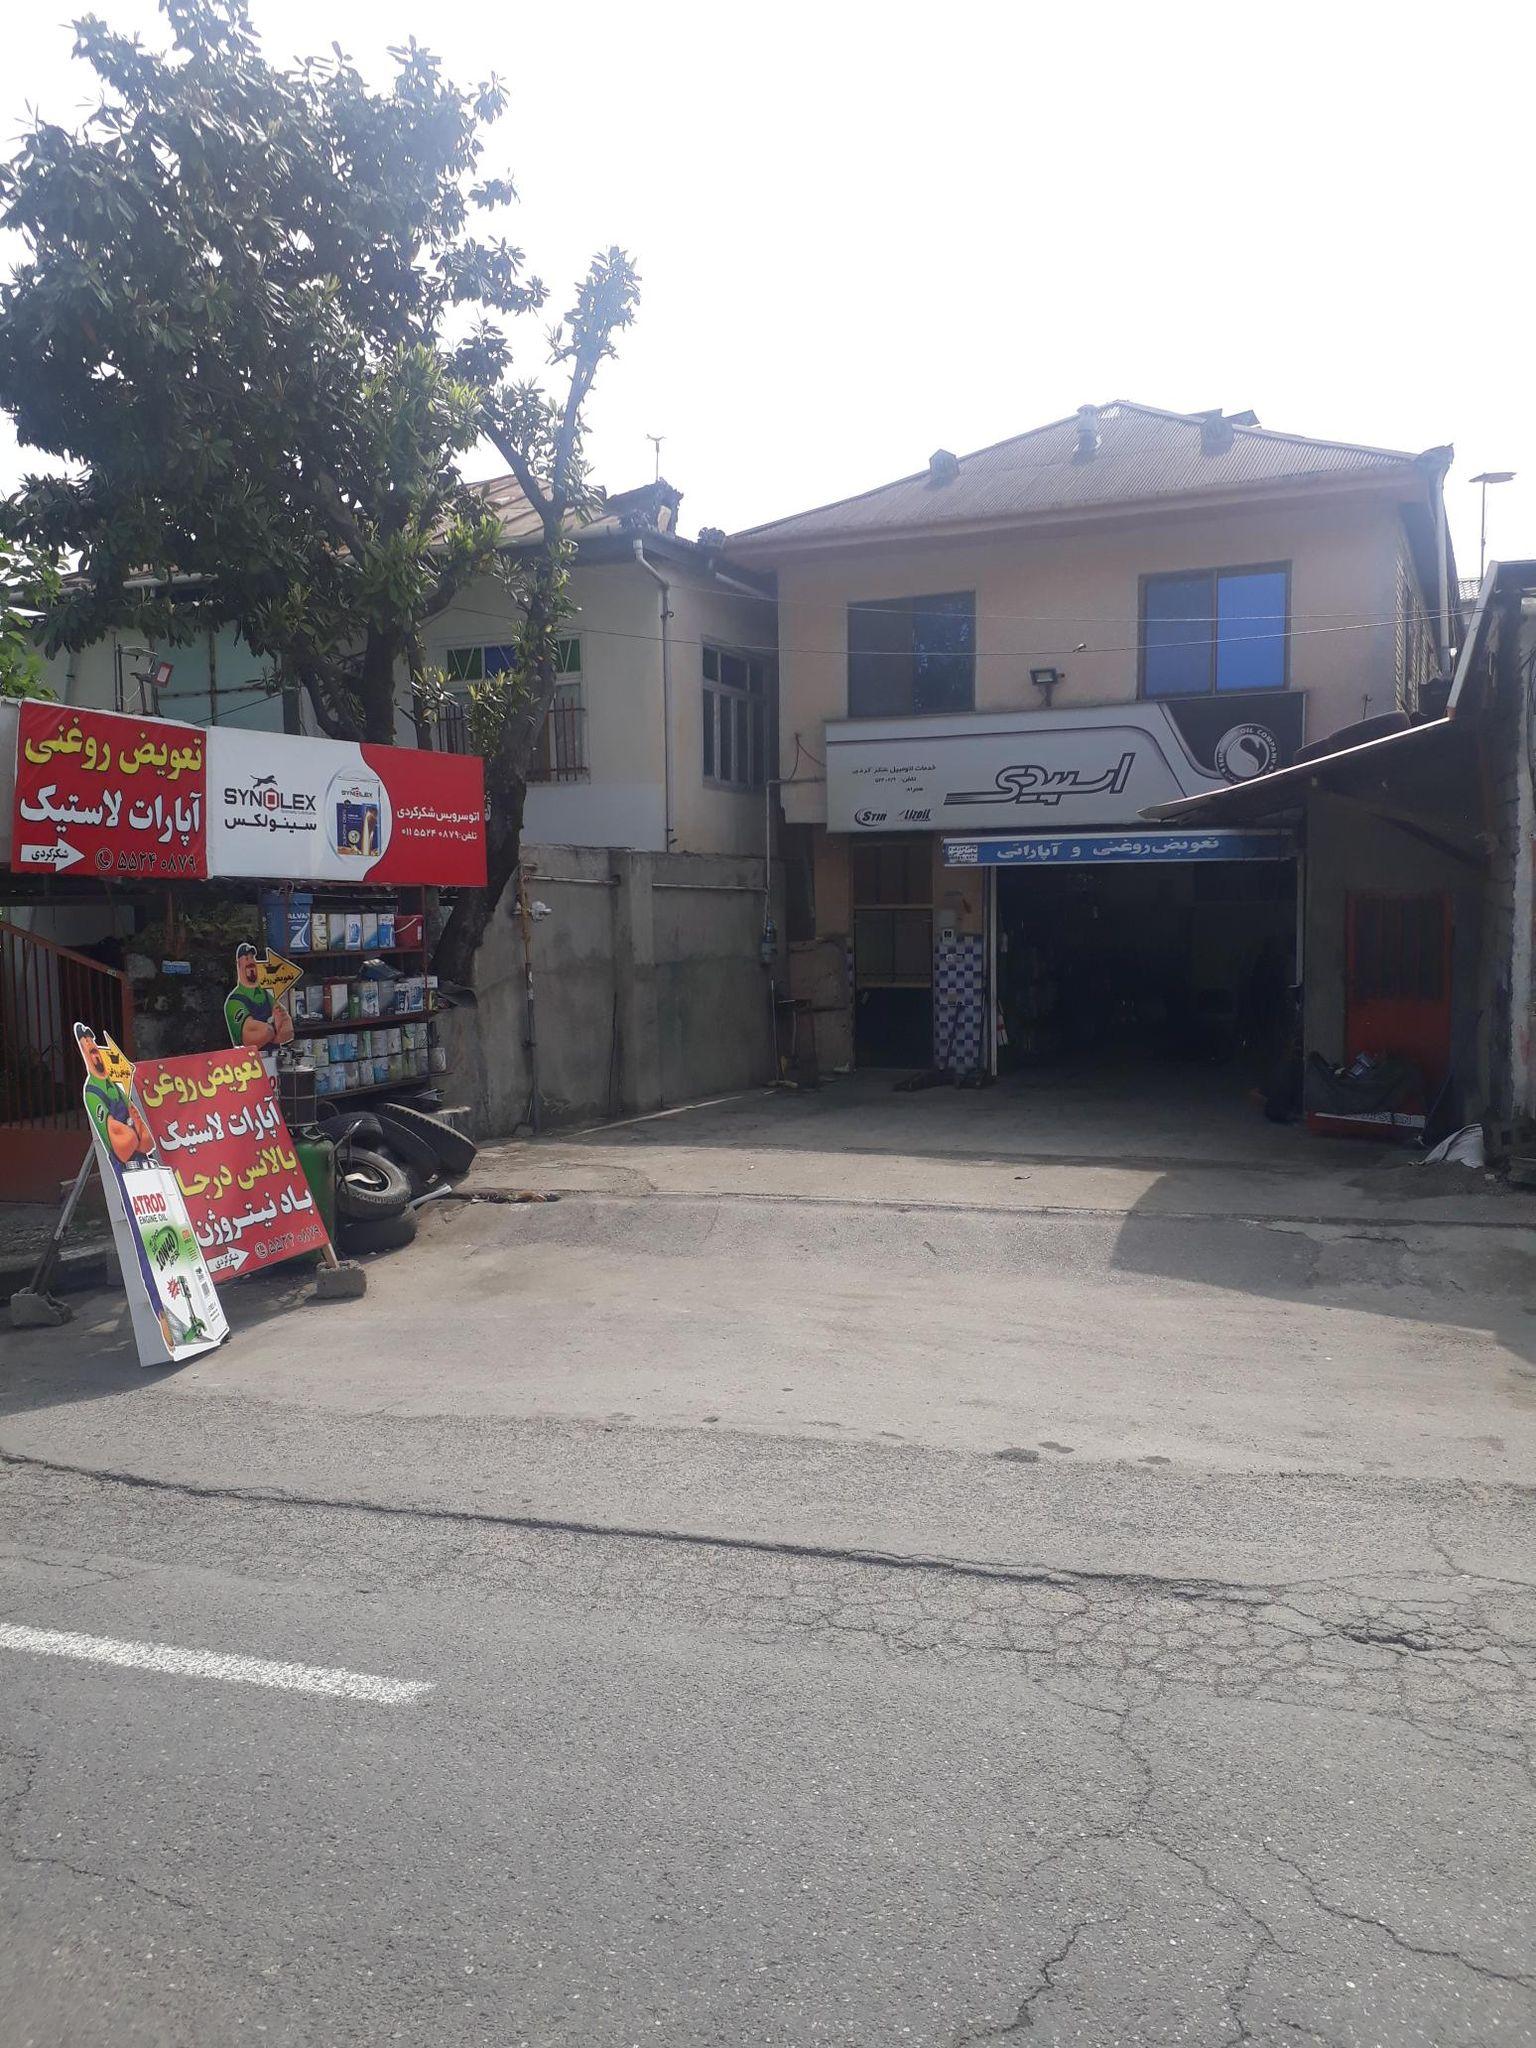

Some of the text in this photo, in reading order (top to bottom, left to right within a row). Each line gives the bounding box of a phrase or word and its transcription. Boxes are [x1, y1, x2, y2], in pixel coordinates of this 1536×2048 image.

[25, 717, 202, 780] تعویض روغنی
[224, 787, 316, 811] SYNOLEX
[20, 784, 202, 847] آپارات لاستیک
[224, 813, 317, 833] سینولکس
[436, 811, 480, 824] اتوسرویس
[997, 842, 1064, 860] آپاراتی
[1070, 845, 1081, 858] و
[1093, 839, 1151, 856] روغنی
[1152, 837, 1220, 856] تعویض
[117, 850, 197, 873] ۵۵۲۴ ۰۸۷۹
[142, 1064, 198, 1108] روغن
[198, 1051, 264, 1098] تعویض
[159, 1096, 281, 1154] آپارات لاستیک
[174, 1144, 298, 1200] بالانس درجا
[132, 1192, 167, 1216] ATROD
[280, 1184, 314, 1215] باد
[138, 1213, 168, 1226] ENGINE OIL
[195, 1192, 278, 1248] نیتروژن
